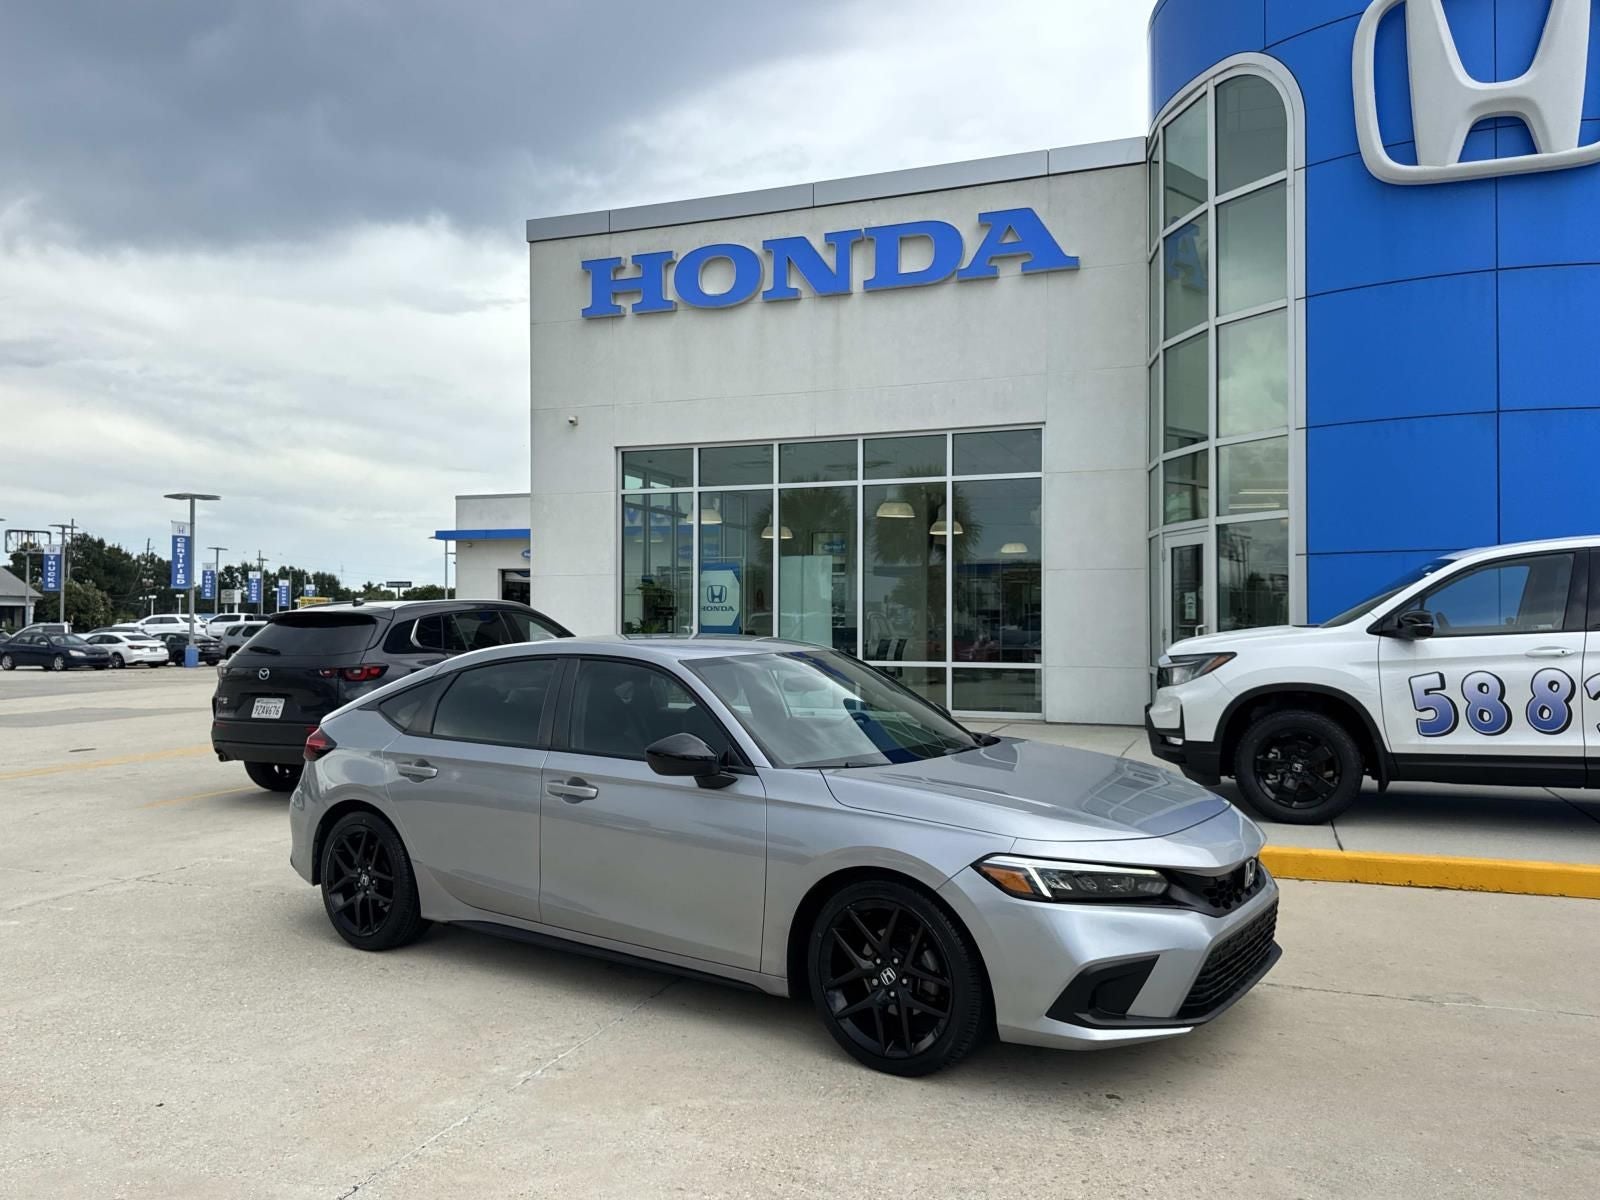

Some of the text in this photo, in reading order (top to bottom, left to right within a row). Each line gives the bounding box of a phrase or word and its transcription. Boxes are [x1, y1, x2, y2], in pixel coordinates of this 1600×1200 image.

[581, 207, 1080, 320] HONDA
[47, 555, 57, 588] TRUCKS
[176, 537, 186, 585] CERTIFIED
